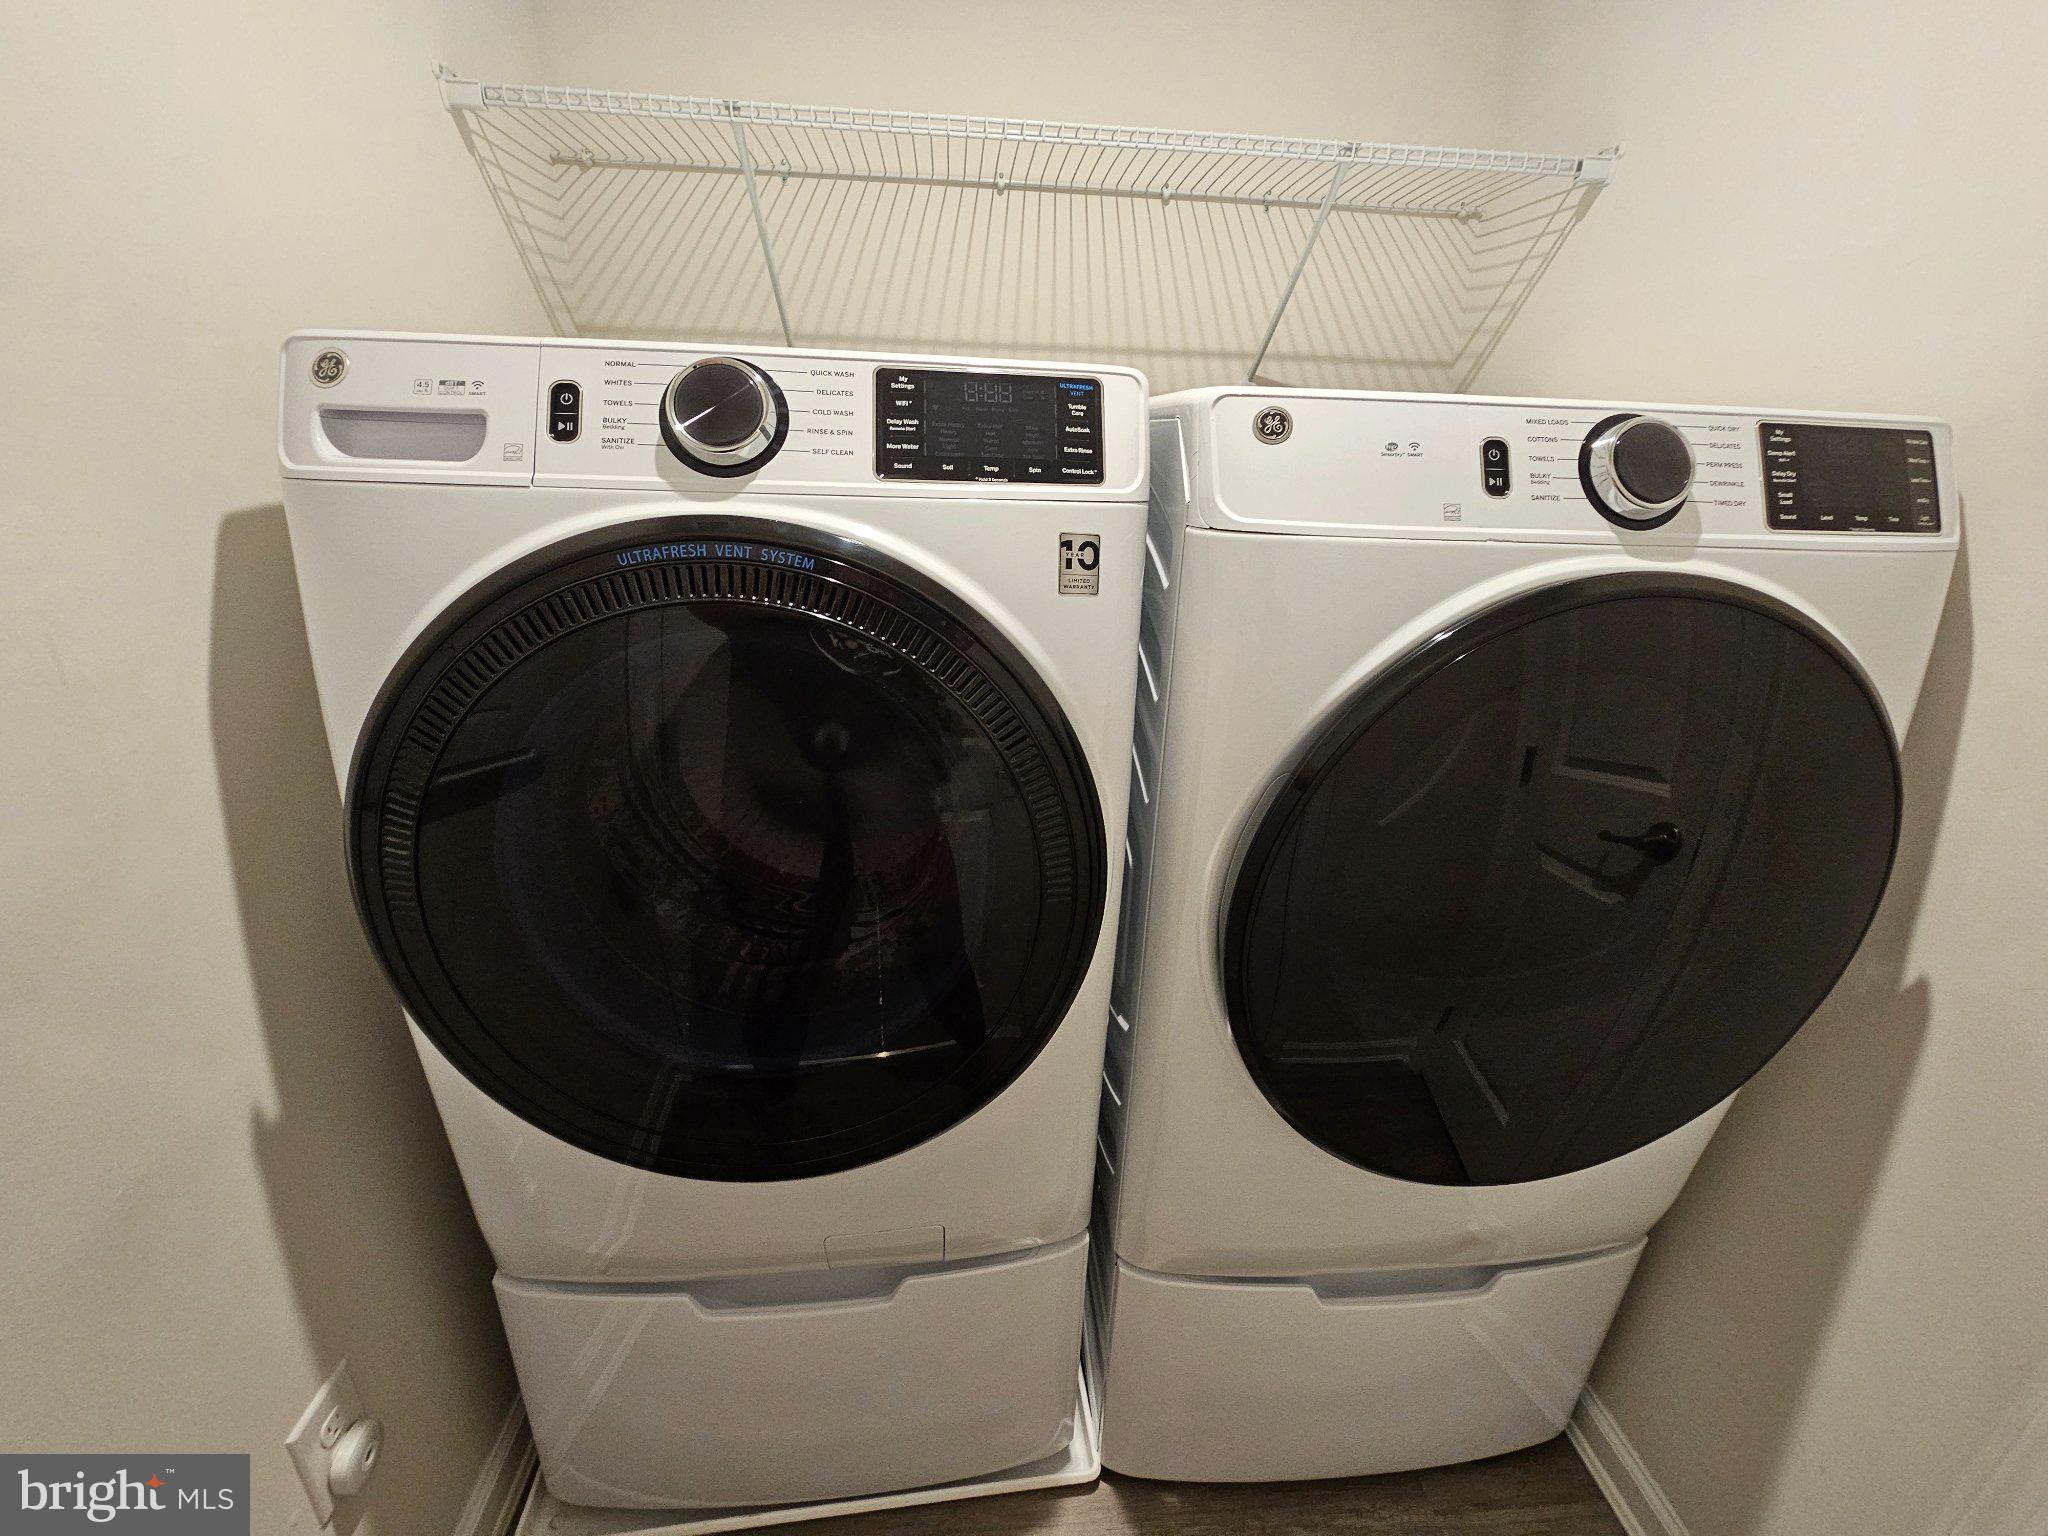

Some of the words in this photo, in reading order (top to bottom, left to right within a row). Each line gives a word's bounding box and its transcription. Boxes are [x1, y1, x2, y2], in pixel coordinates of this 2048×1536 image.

[810, 369, 833, 377] QUICK
[603, 379, 633, 387] WHITES
[898, 375, 909, 383] My
[890, 383, 915, 391] Settings
[1059, 383, 1094, 392] ULTRAFRESH
[816, 389, 854, 397] DELICATES
[603, 399, 633, 407] TOWELS
[1067, 403, 1087, 411] Tumble
[812, 408, 832, 416] COLD
[602, 416, 628, 424] BULKY
[886, 418, 903, 426] Delay
[903, 418, 920, 426] Wash
[1065, 426, 1091, 434] AutoSoak
[601, 437, 635, 445] SANITIZE
[1709, 442, 1742, 450] DELICATES
[983, 465, 1000, 473] Temp
[1028, 466, 1042, 474] Spin
[1061, 467, 1082, 475] Control
[1709, 480, 1745, 488] DEWRINKLE
[616, 543, 708, 567] ULTRAFRESH
[715, 543, 753, 560] VENT
[760, 548, 816, 571] SYSTEM
[1060, 540, 1099, 571] 10
